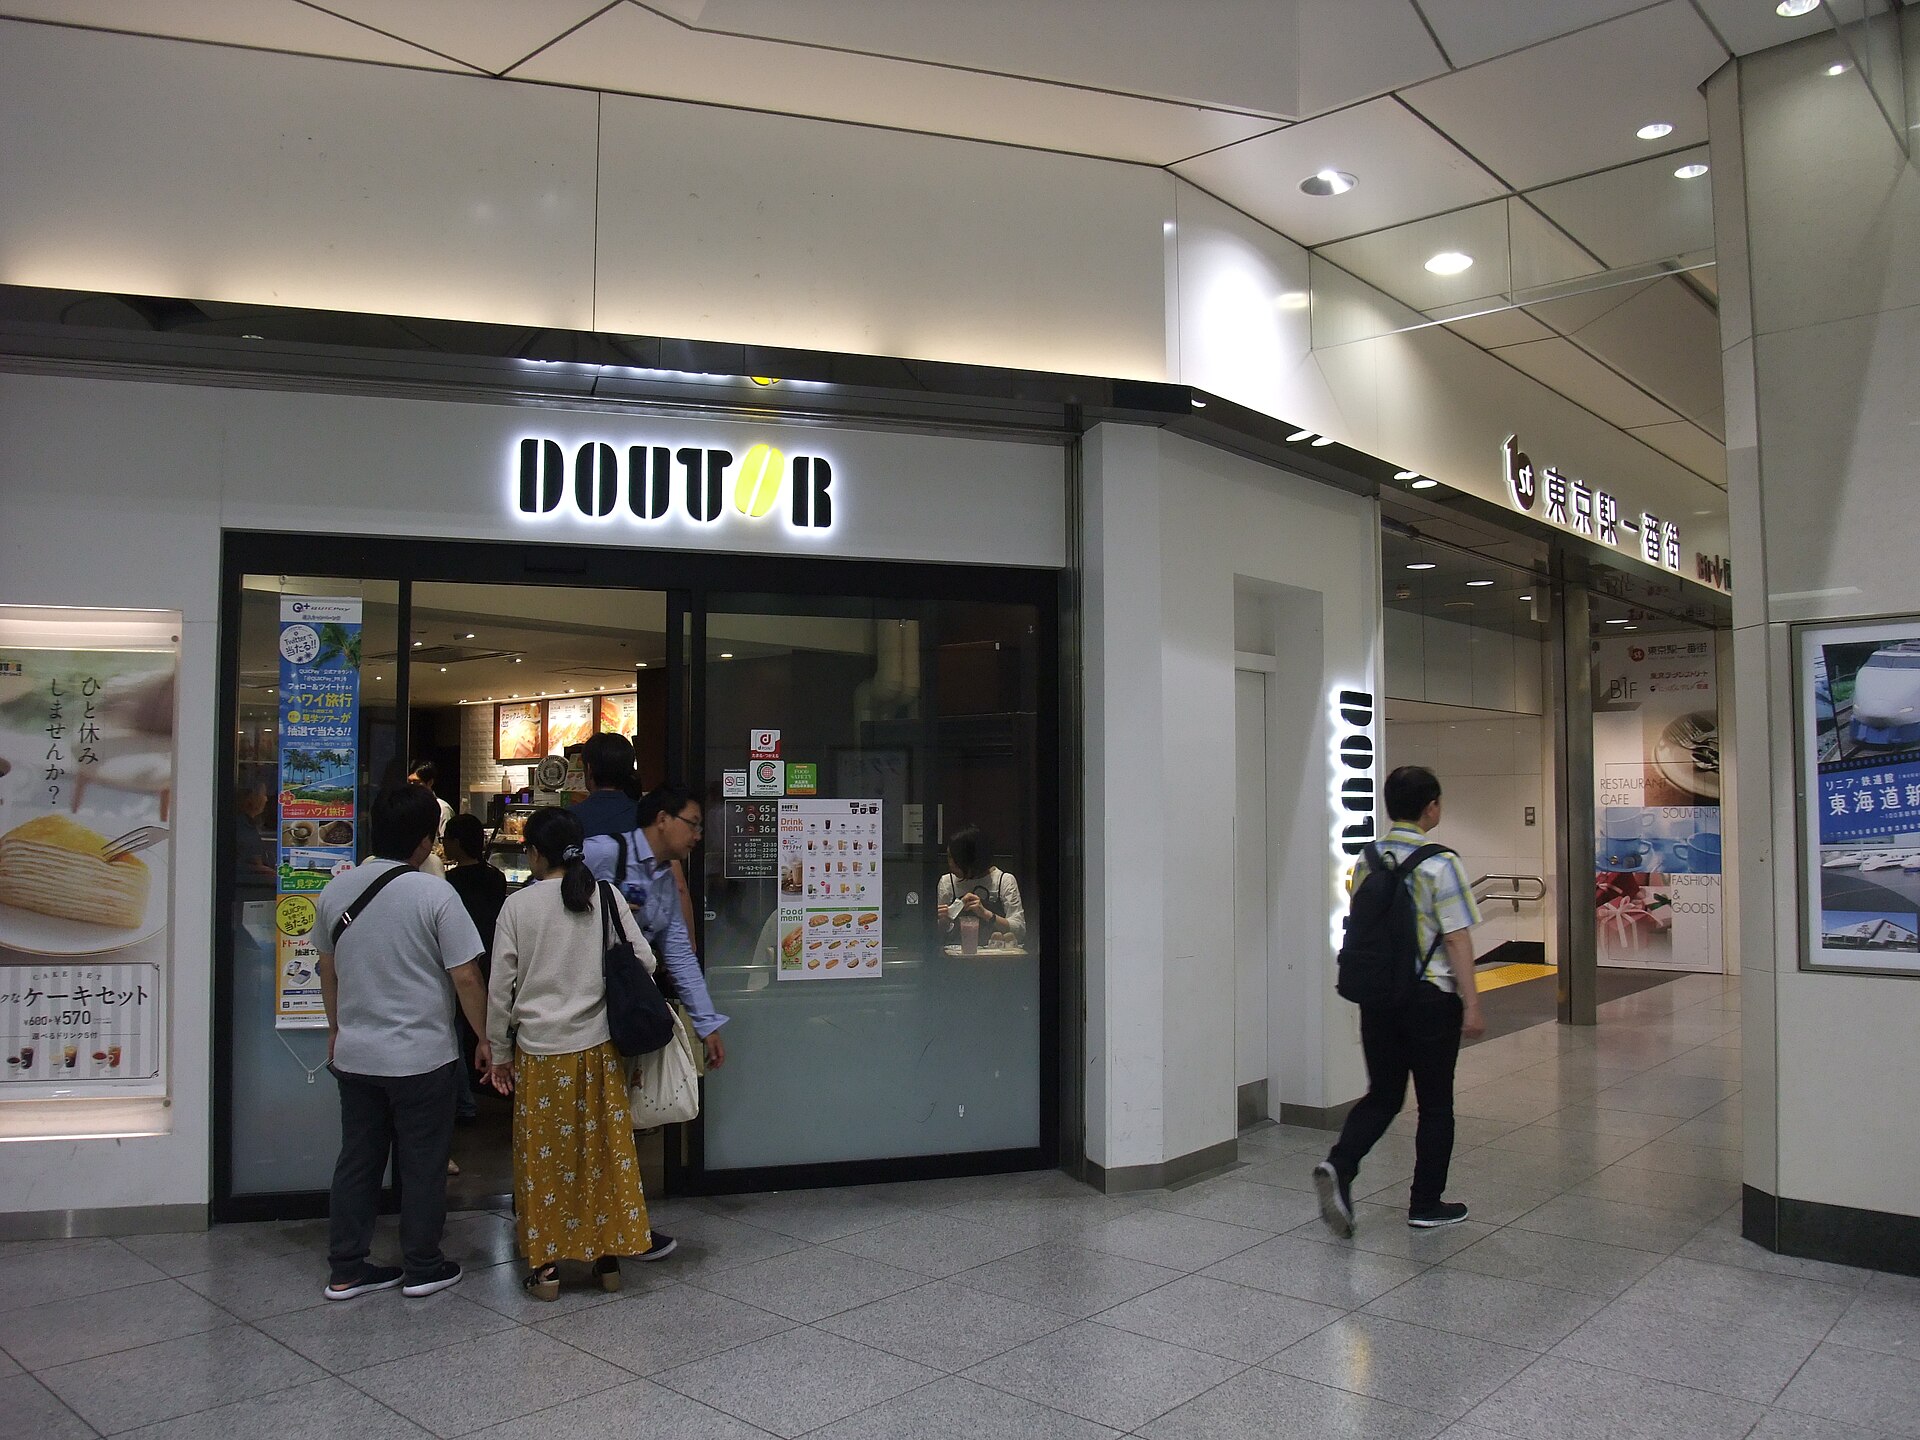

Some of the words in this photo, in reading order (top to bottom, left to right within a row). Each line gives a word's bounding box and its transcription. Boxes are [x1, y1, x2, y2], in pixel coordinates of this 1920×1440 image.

[520, 438, 832, 528] DOUTOR
[1542, 466, 1681, 572] 東京駅一番街
[1648, 642, 1707, 656] 東京駅一番街
[1610, 677, 1637, 699] B1F
[287, 692, 353, 708] ハワイ旅行
[78, 677, 101, 765] ひと休み
[45, 678, 67, 805] しませんか？
[1600, 778, 1666, 790] RESTAURANT
[1825, 773, 1895, 791] リニア・鉄道館
[1600, 794, 1629, 805] CAFE
[735, 805, 744, 813] 2F
[1663, 807, 1718, 819] SOUVENIR
[780, 817, 804, 826] Drink
[735, 826, 744, 834] 1F
[1672, 875, 1719, 887] FASHION
[1673, 889, 1681, 900] &
[780, 907, 803, 915] Food
[1671, 902, 1715, 914] GOODS
[33, 971, 68, 981] CAKE
[77, 971, 103, 981] SET
